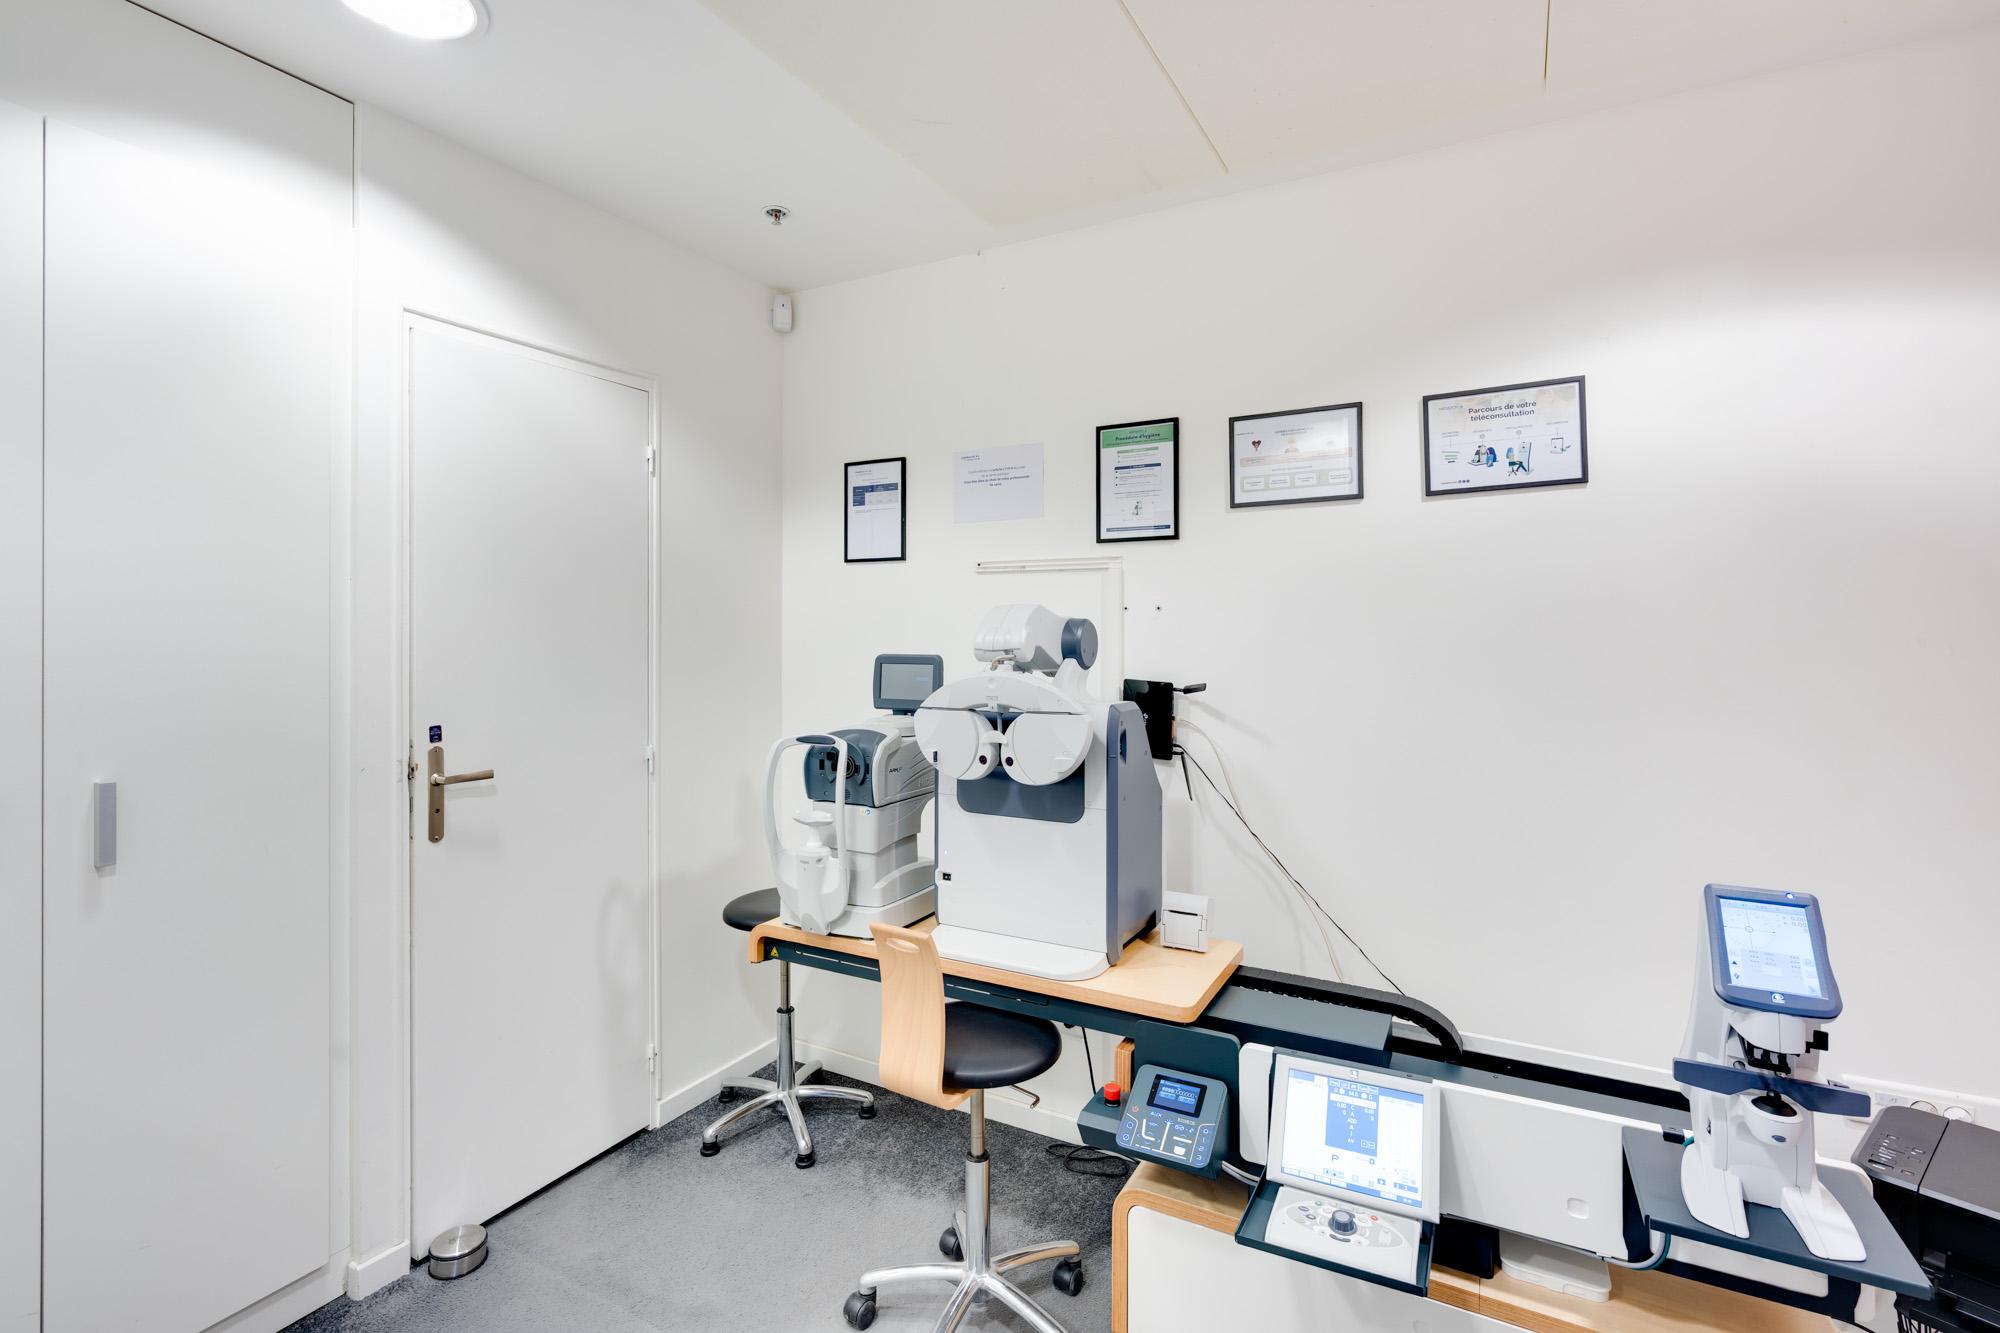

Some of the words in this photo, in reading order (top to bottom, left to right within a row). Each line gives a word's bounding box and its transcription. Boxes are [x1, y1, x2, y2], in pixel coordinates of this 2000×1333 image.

[1468, 405, 1503, 414] Parcours
[1516, 401, 1537, 409] votre
[1470, 409, 1535, 421] téléconsultation
